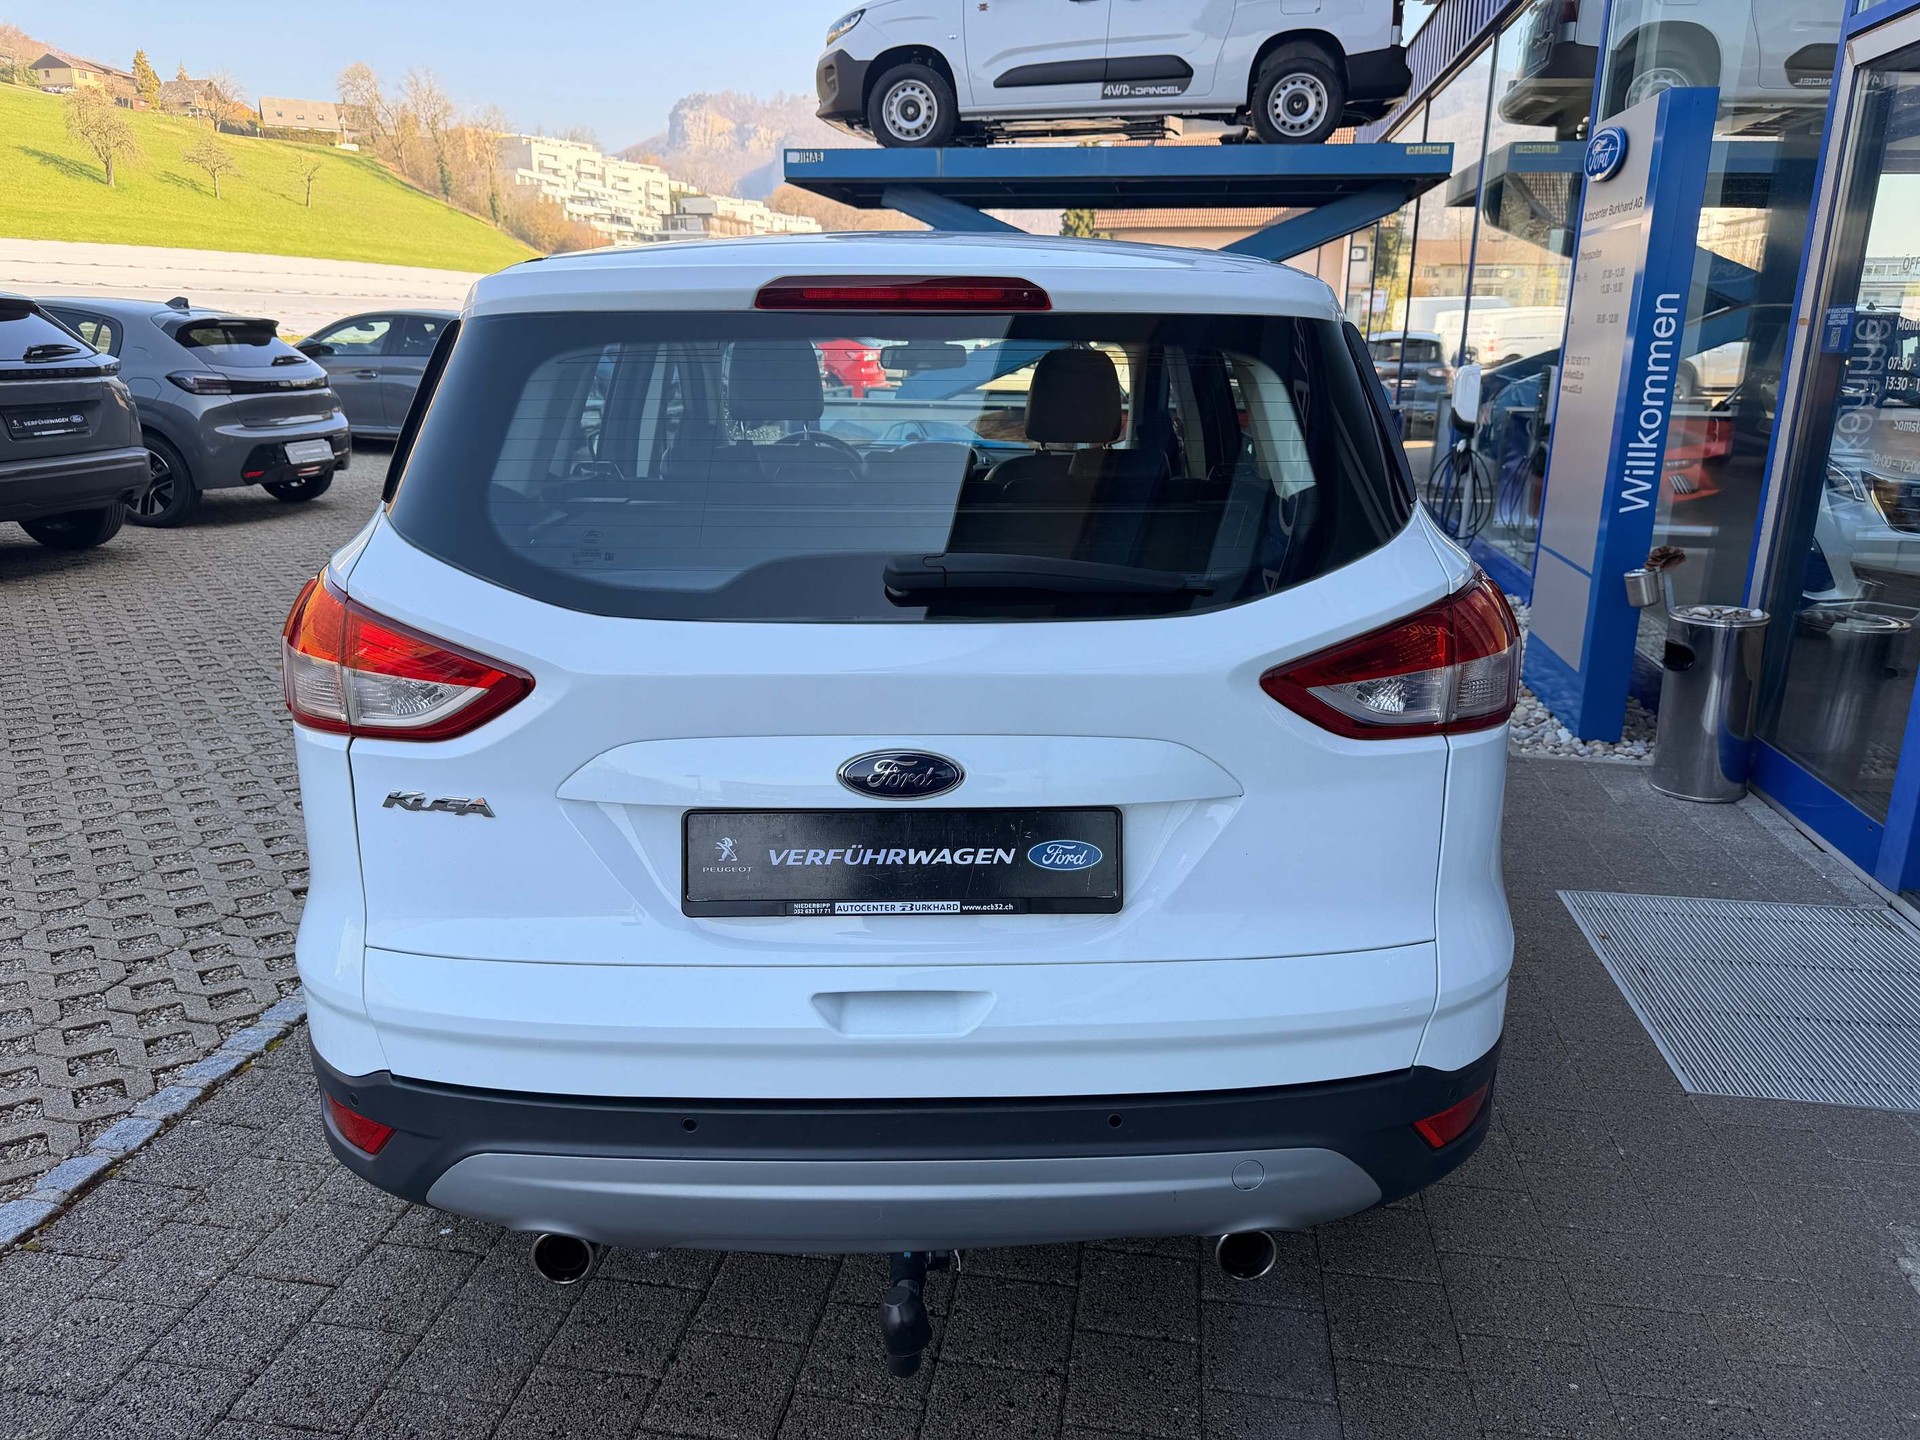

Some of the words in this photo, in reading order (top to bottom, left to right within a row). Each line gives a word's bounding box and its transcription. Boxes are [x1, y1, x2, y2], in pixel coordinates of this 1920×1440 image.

[1103, 84, 1130, 97] 4WD
[1134, 85, 1182, 96] DANGEL
[1608, 199, 1634, 217] Burkhard
[1633, 196, 1644, 213] AG
[1896, 317, 1920, 331] Mont
[1887, 356, 1912, 371] 07:30
[1885, 376, 1908, 391] 13:30
[1619, 294, 1681, 514] Willkommen
[1893, 419, 1920, 433] Samst
[866, 758, 935, 789] Ford
[768, 844, 1017, 867] VERFÜHRWAGEN
[1042, 843, 1088, 866] Ford
[836, 904, 897, 913] AUTOCENTER
[961, 903, 1014, 911] www.acb32.ch
